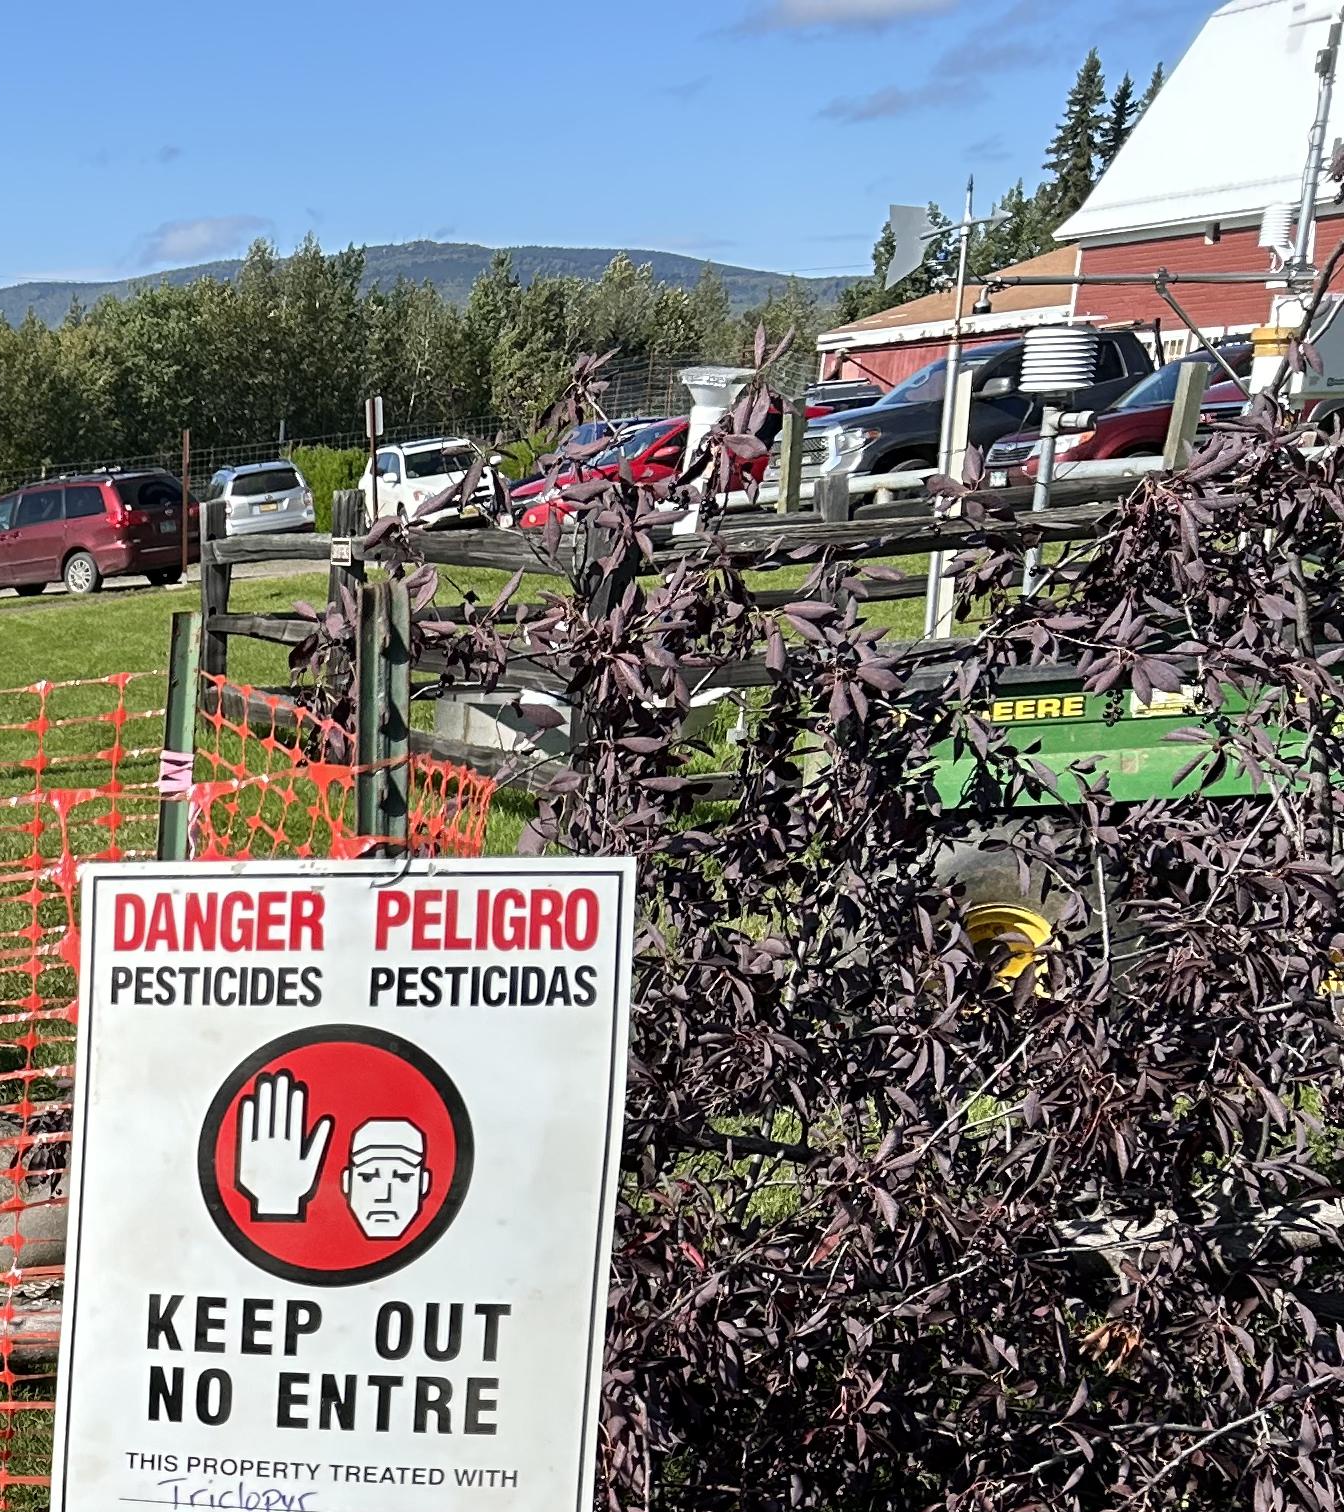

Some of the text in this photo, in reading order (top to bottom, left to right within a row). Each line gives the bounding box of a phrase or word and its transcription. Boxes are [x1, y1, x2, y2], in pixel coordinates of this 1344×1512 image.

[982, 696, 1085, 723] EERE
[114, 888, 600, 952] DANGER PELIGRO
[111, 965, 598, 1008] PESTICIDES PESTICIDAS
[146, 1293, 513, 1362] KEEP OUT
[147, 1366, 501, 1436] NO ENTRE
[125, 1452, 519, 1488] THIS PROPERTY TREATED WITH
